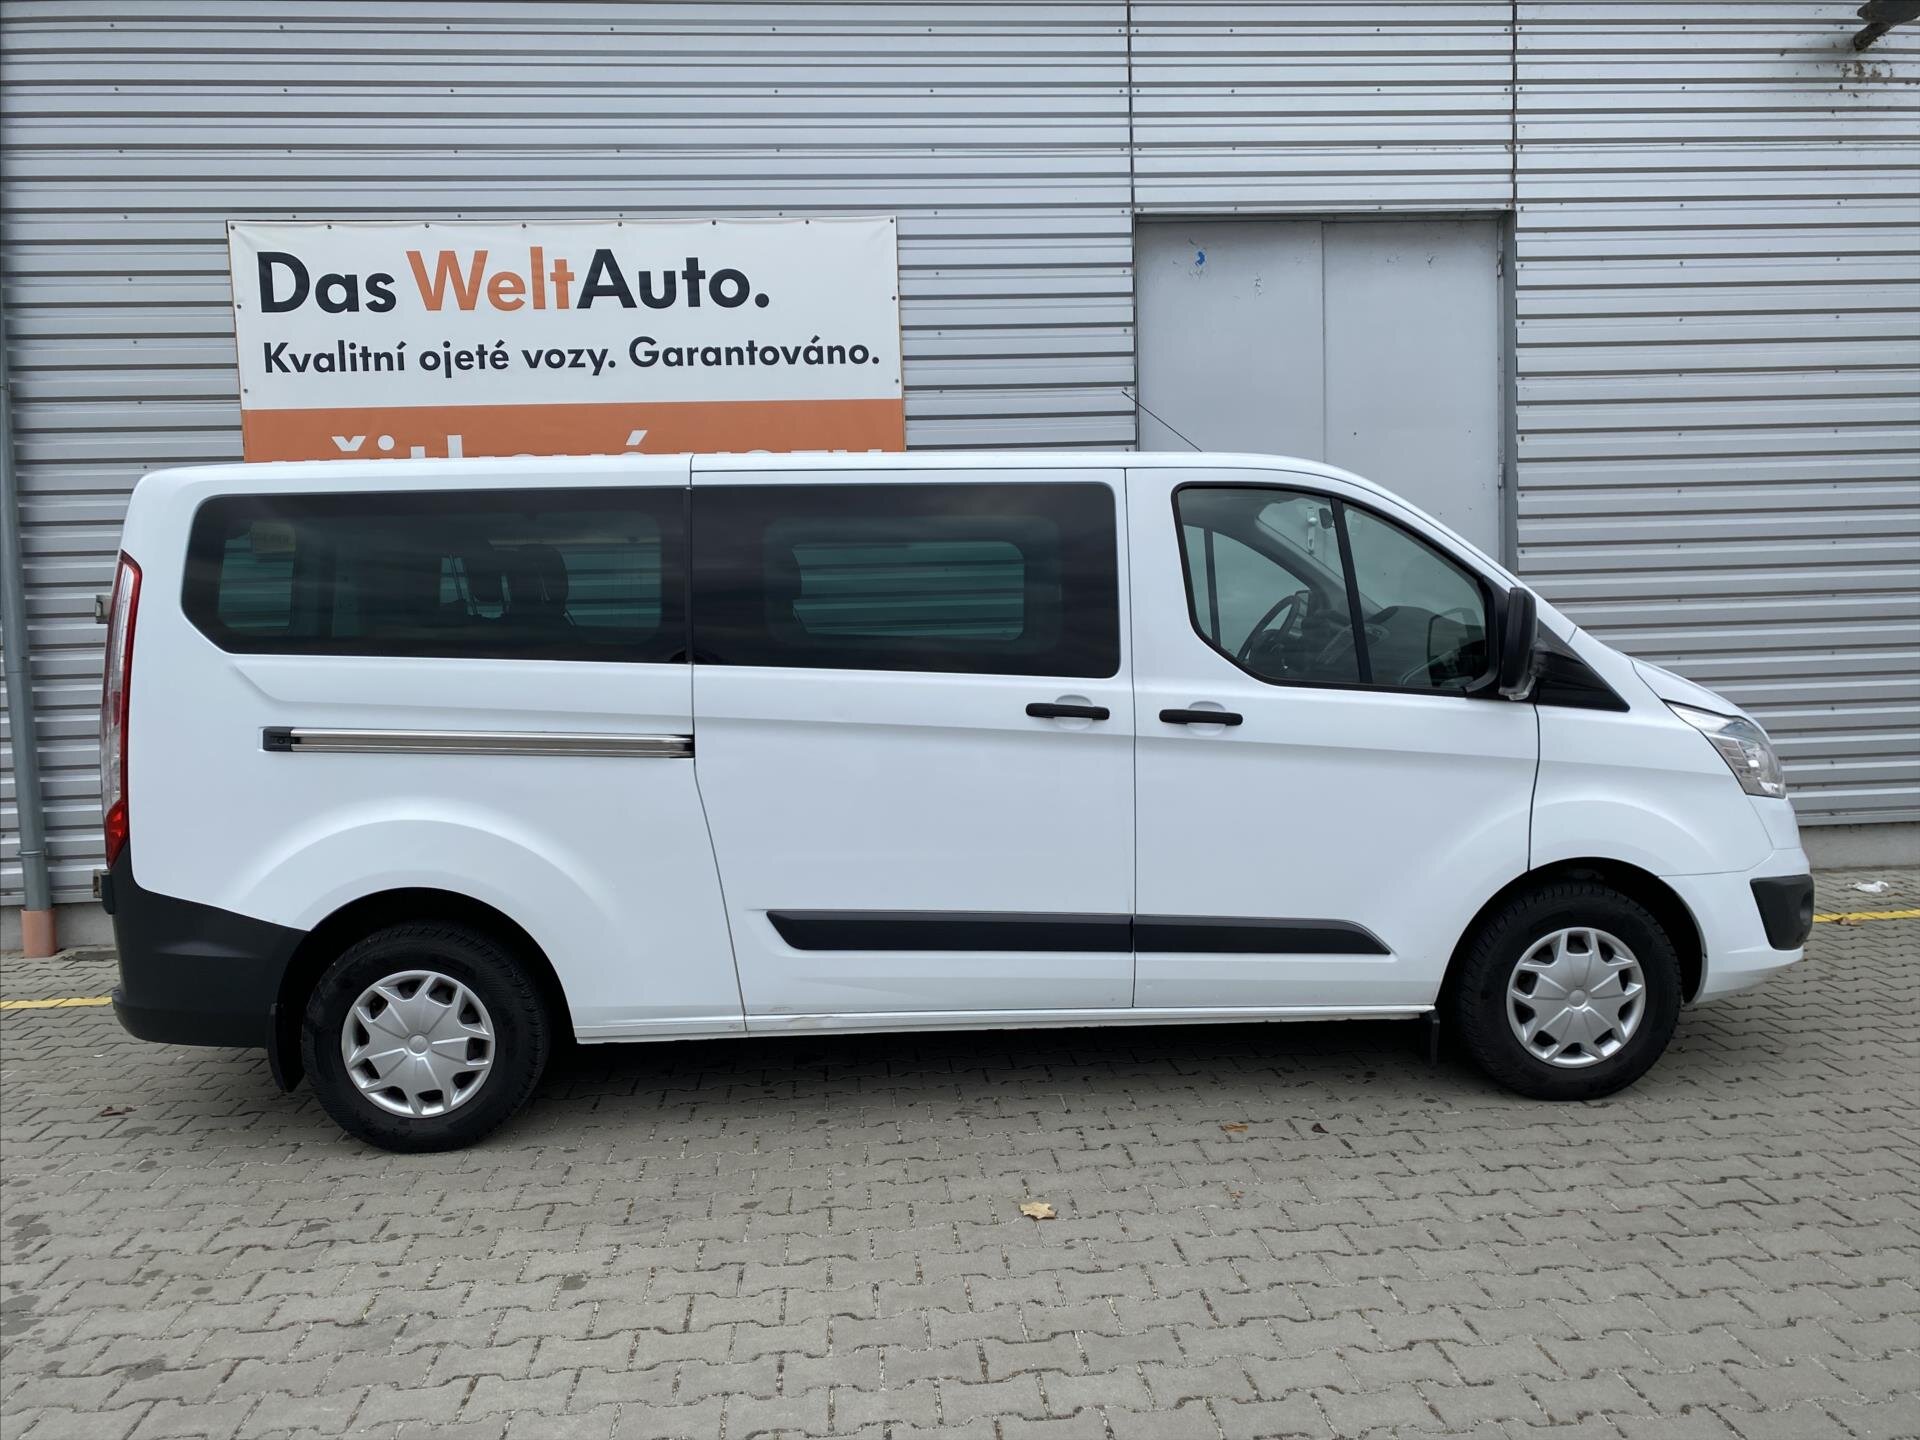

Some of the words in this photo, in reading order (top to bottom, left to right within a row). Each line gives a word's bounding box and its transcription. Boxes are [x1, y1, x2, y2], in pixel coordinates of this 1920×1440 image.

[257, 252, 396, 313] Das
[406, 246, 769, 312] WeltAuto.
[264, 340, 407, 374] Kvalitní
[419, 339, 510, 379] ojeté
[521, 347, 616, 377] vozy.
[629, 336, 880, 368] Garantováno.
